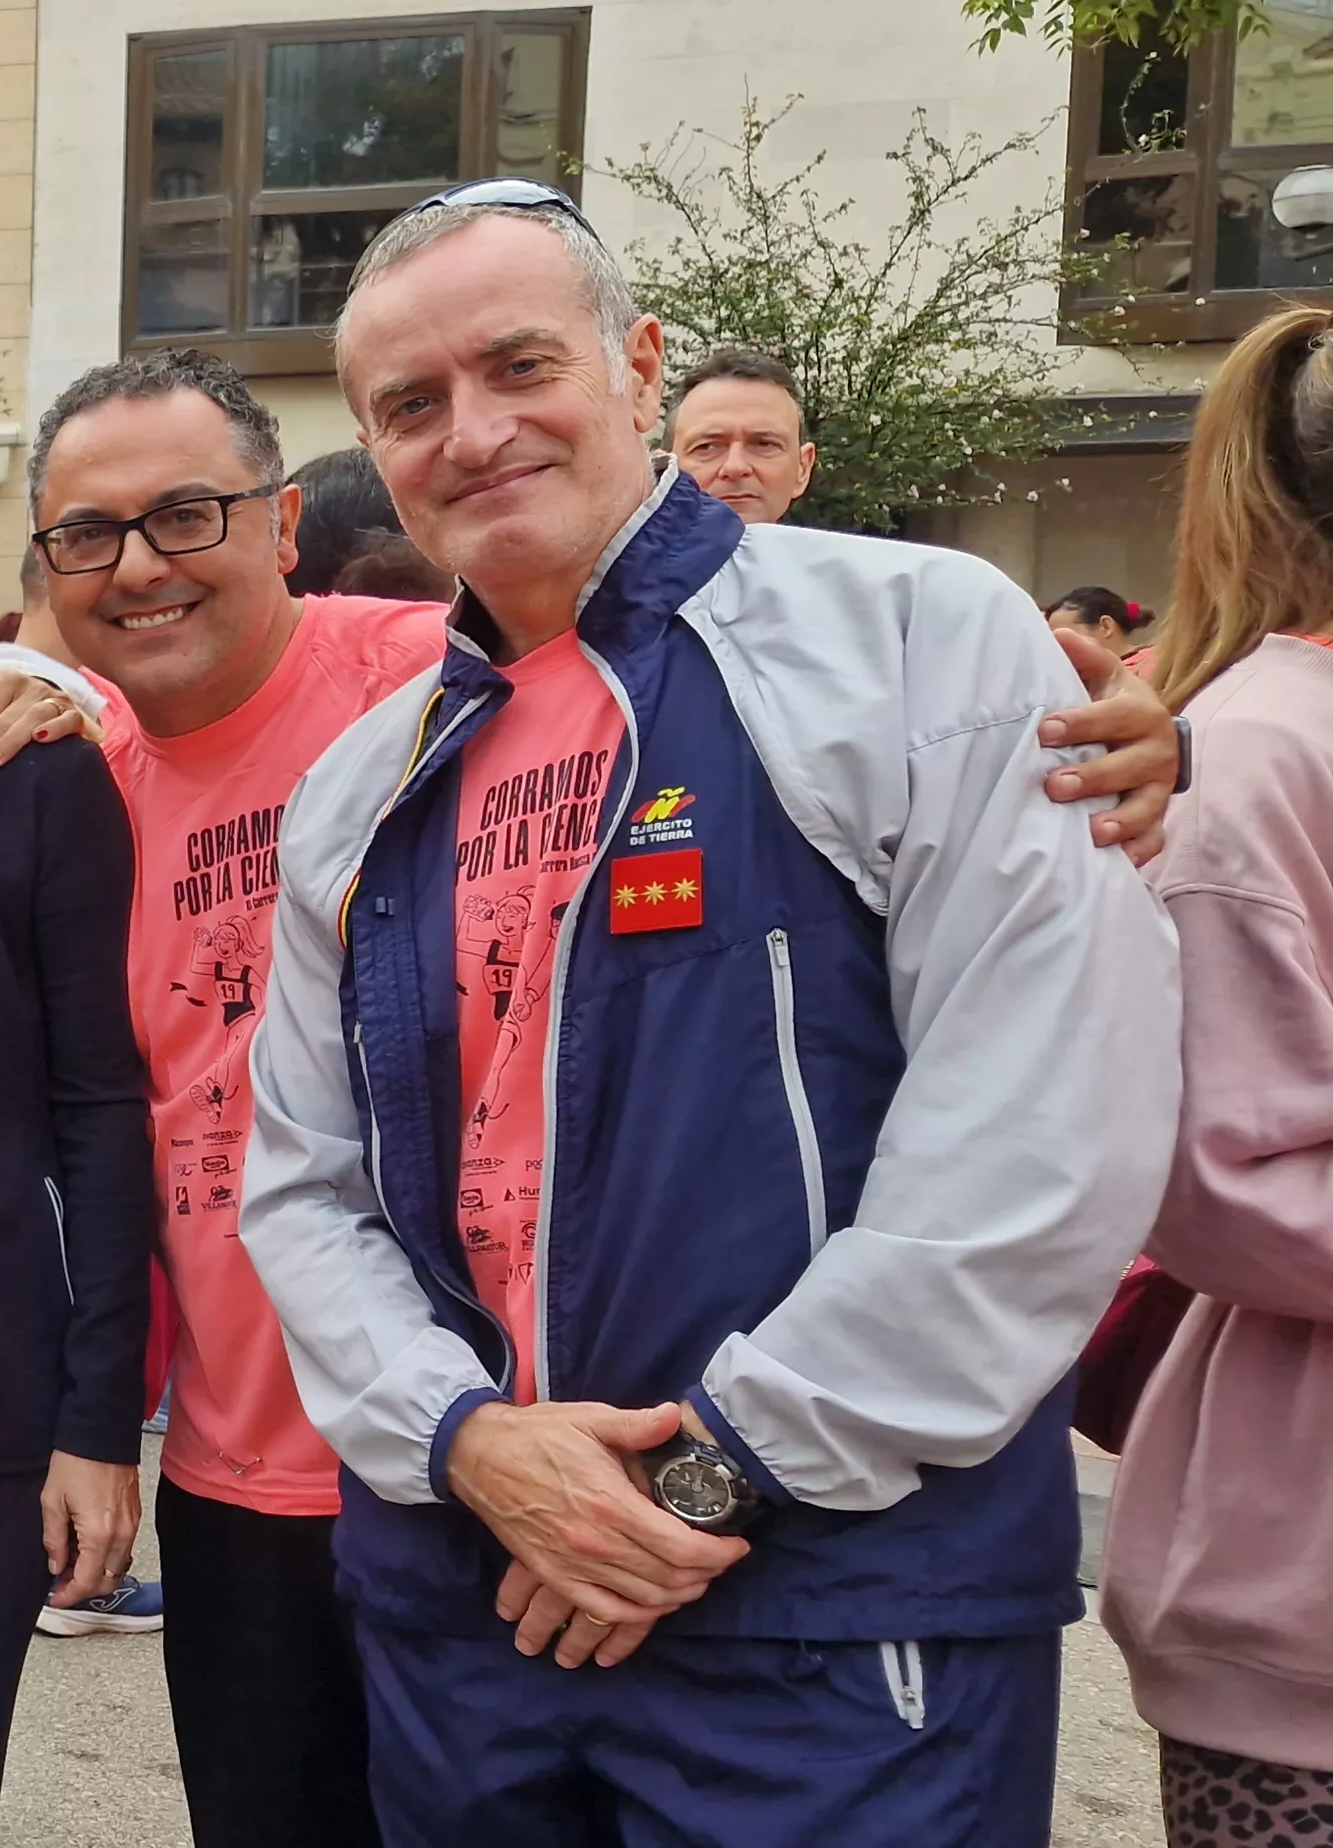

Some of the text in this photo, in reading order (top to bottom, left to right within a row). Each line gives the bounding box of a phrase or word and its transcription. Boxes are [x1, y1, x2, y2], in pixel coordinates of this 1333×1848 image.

[480, 749, 609, 831] CORRAMOS
[187, 804, 285, 873] CORRAMO
[629, 829, 693, 846] DE TIERRA
[630, 818, 693, 835] EJERCITO
[455, 830, 497, 888] POR
[503, 818, 529, 871] LA
[173, 846, 281, 921] POR LA CIEN
[220, 983, 235, 1000] 19
[490, 968, 513, 987] 19
